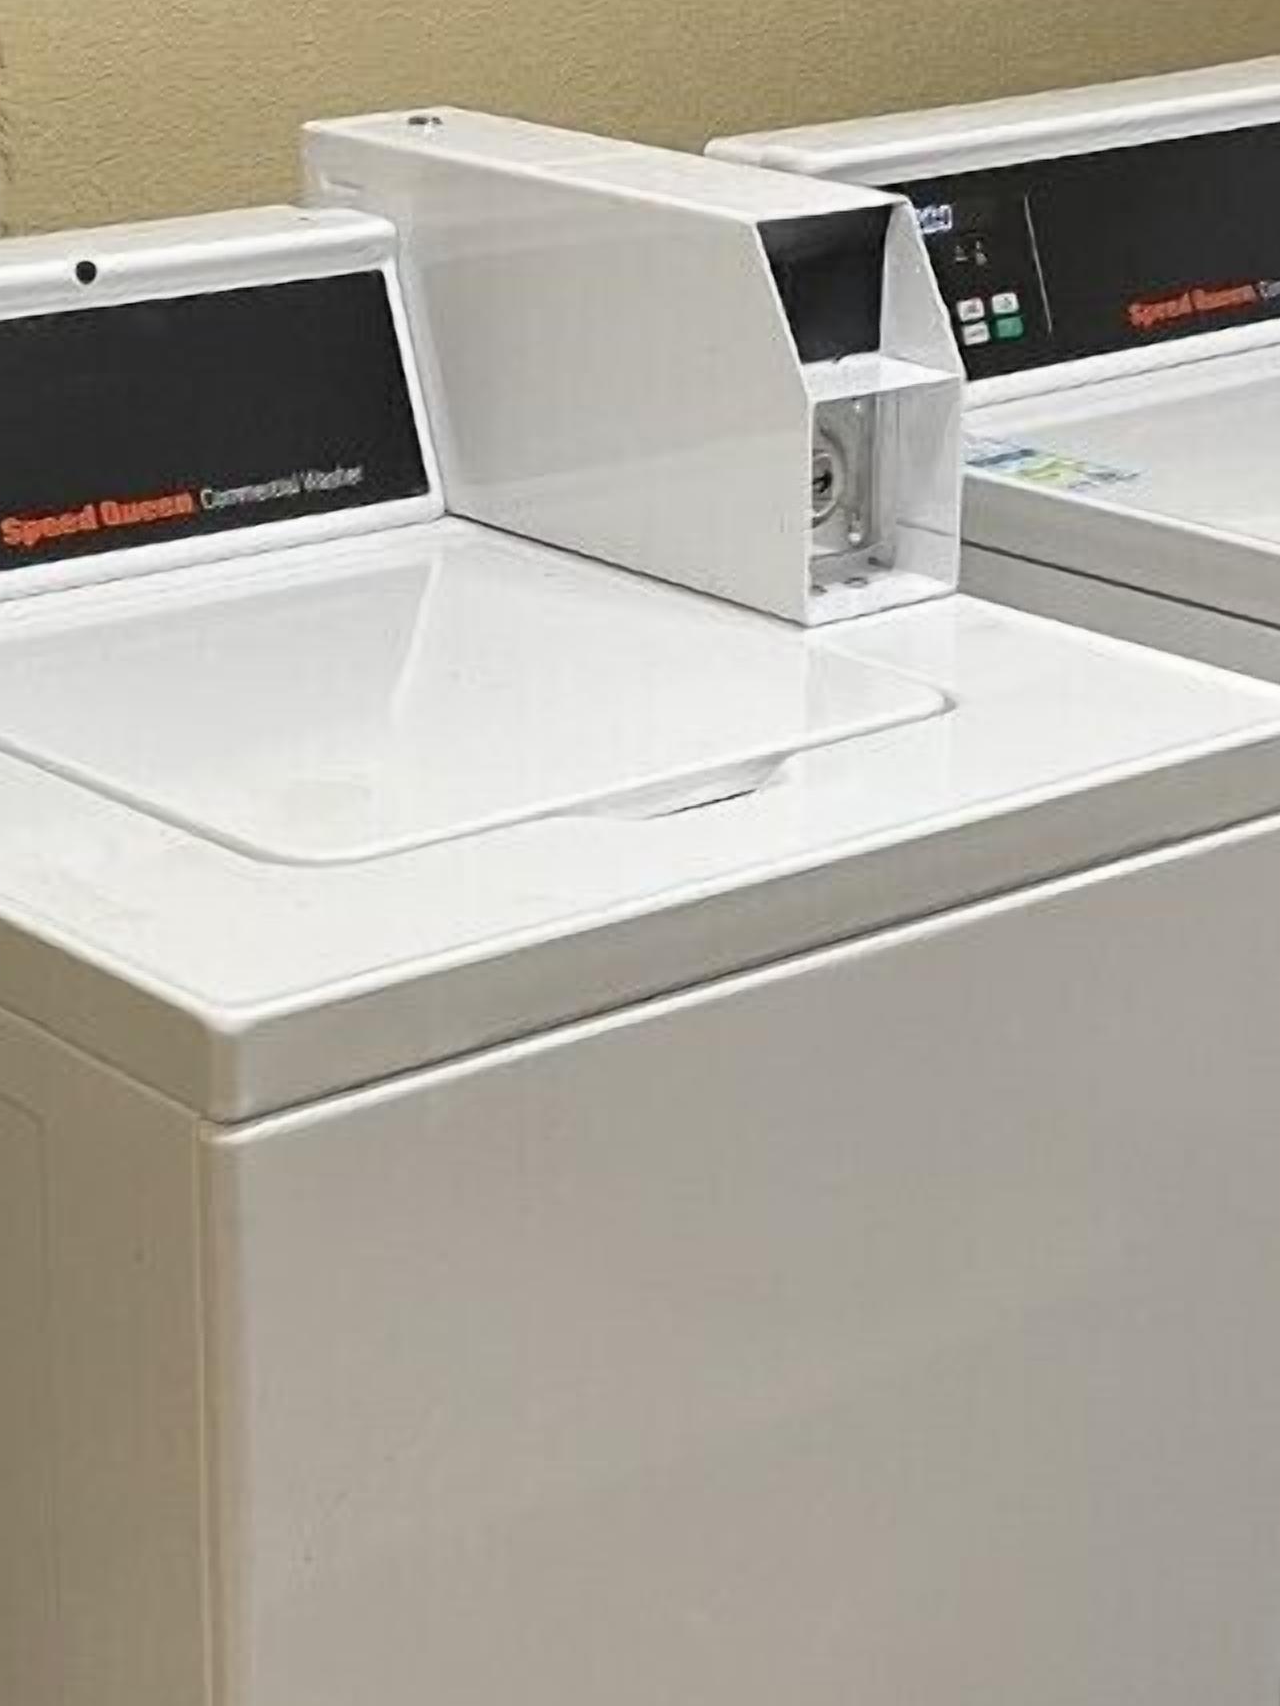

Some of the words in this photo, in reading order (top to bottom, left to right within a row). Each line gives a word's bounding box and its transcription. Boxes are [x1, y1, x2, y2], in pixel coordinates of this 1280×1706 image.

[1127, 293, 1192, 327] Speed
[1190, 284, 1258, 312] Queen
[0, 504, 99, 547] Speed
[100, 490, 198, 527] Queen
[199, 472, 301, 511] Commercial
